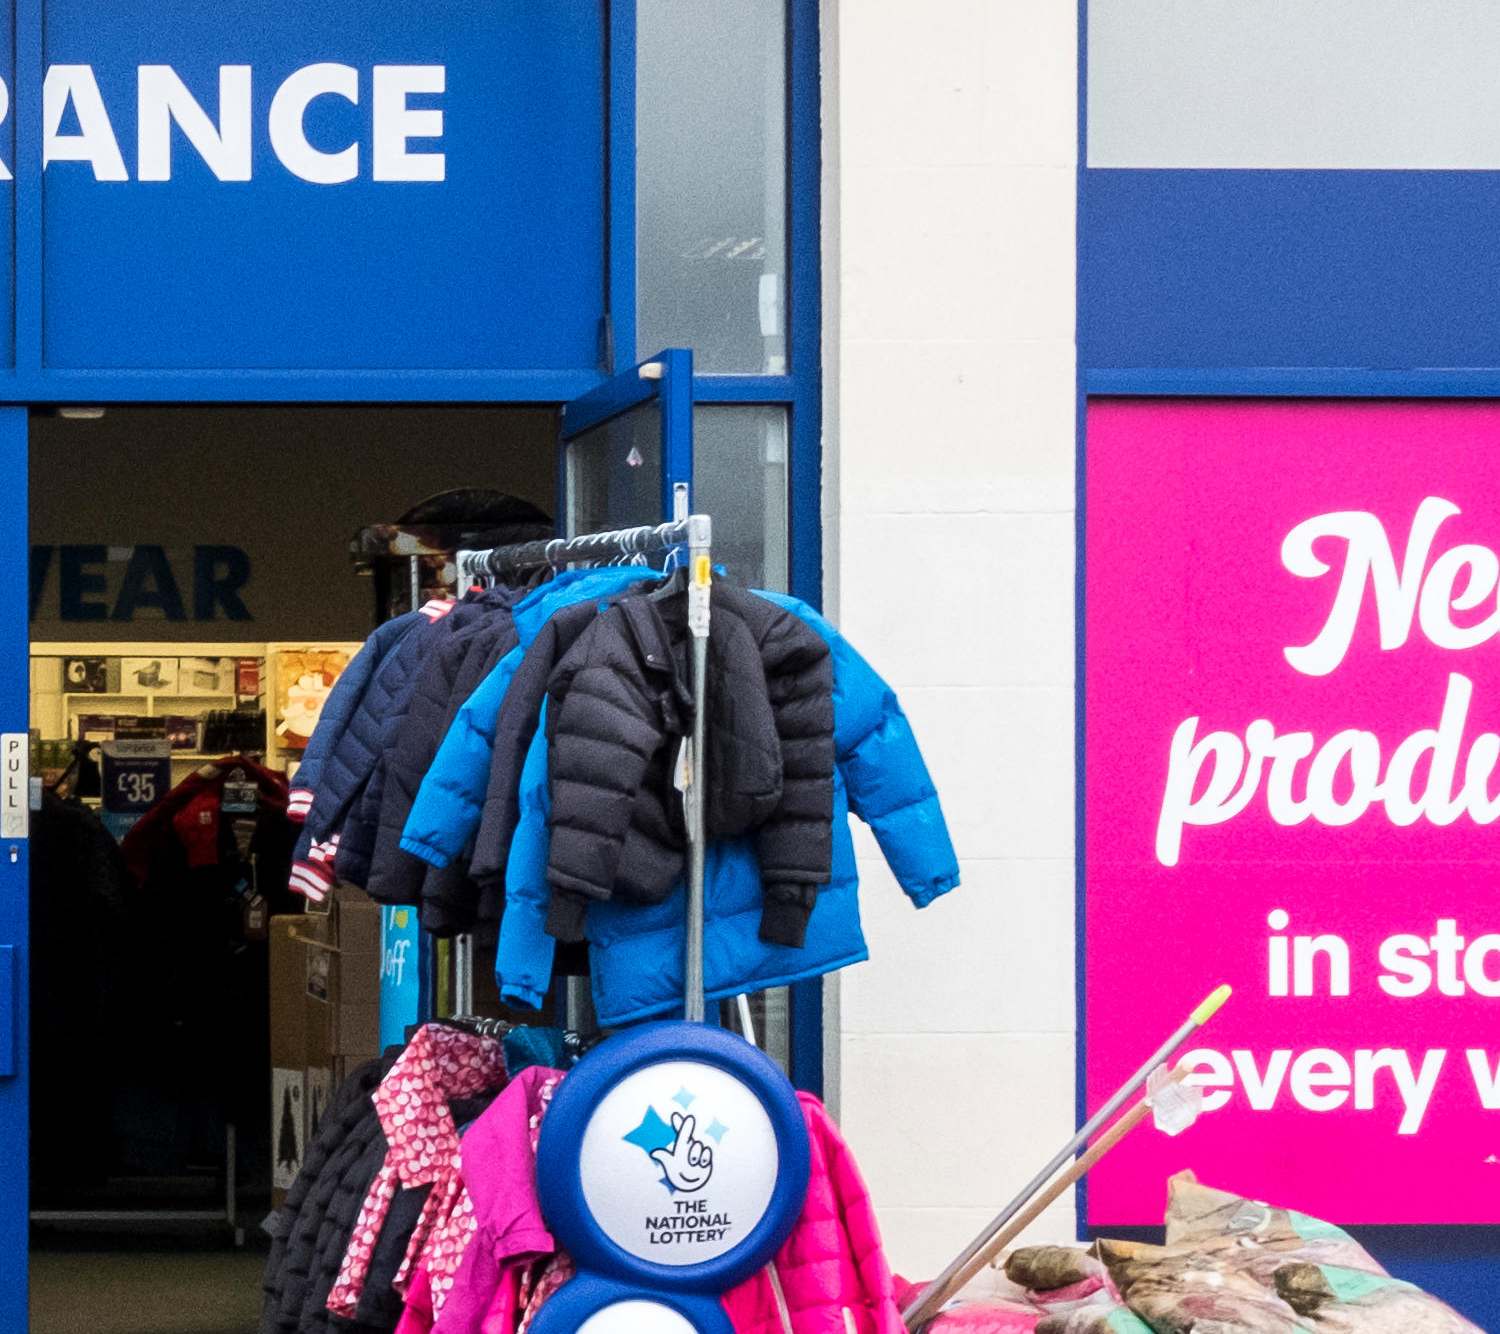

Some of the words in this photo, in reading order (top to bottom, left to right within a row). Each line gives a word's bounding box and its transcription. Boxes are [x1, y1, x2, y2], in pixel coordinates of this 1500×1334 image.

[8, 740, 20, 808] PULL
[117, 773, 156, 803] £35
[1267, 908, 1351, 997] in
[1178, 1047, 1447, 1135] every
[645, 1212, 732, 1231] NATIONAL
[674, 1199, 708, 1214] THE
[649, 1228, 728, 1245] LOTTERY
